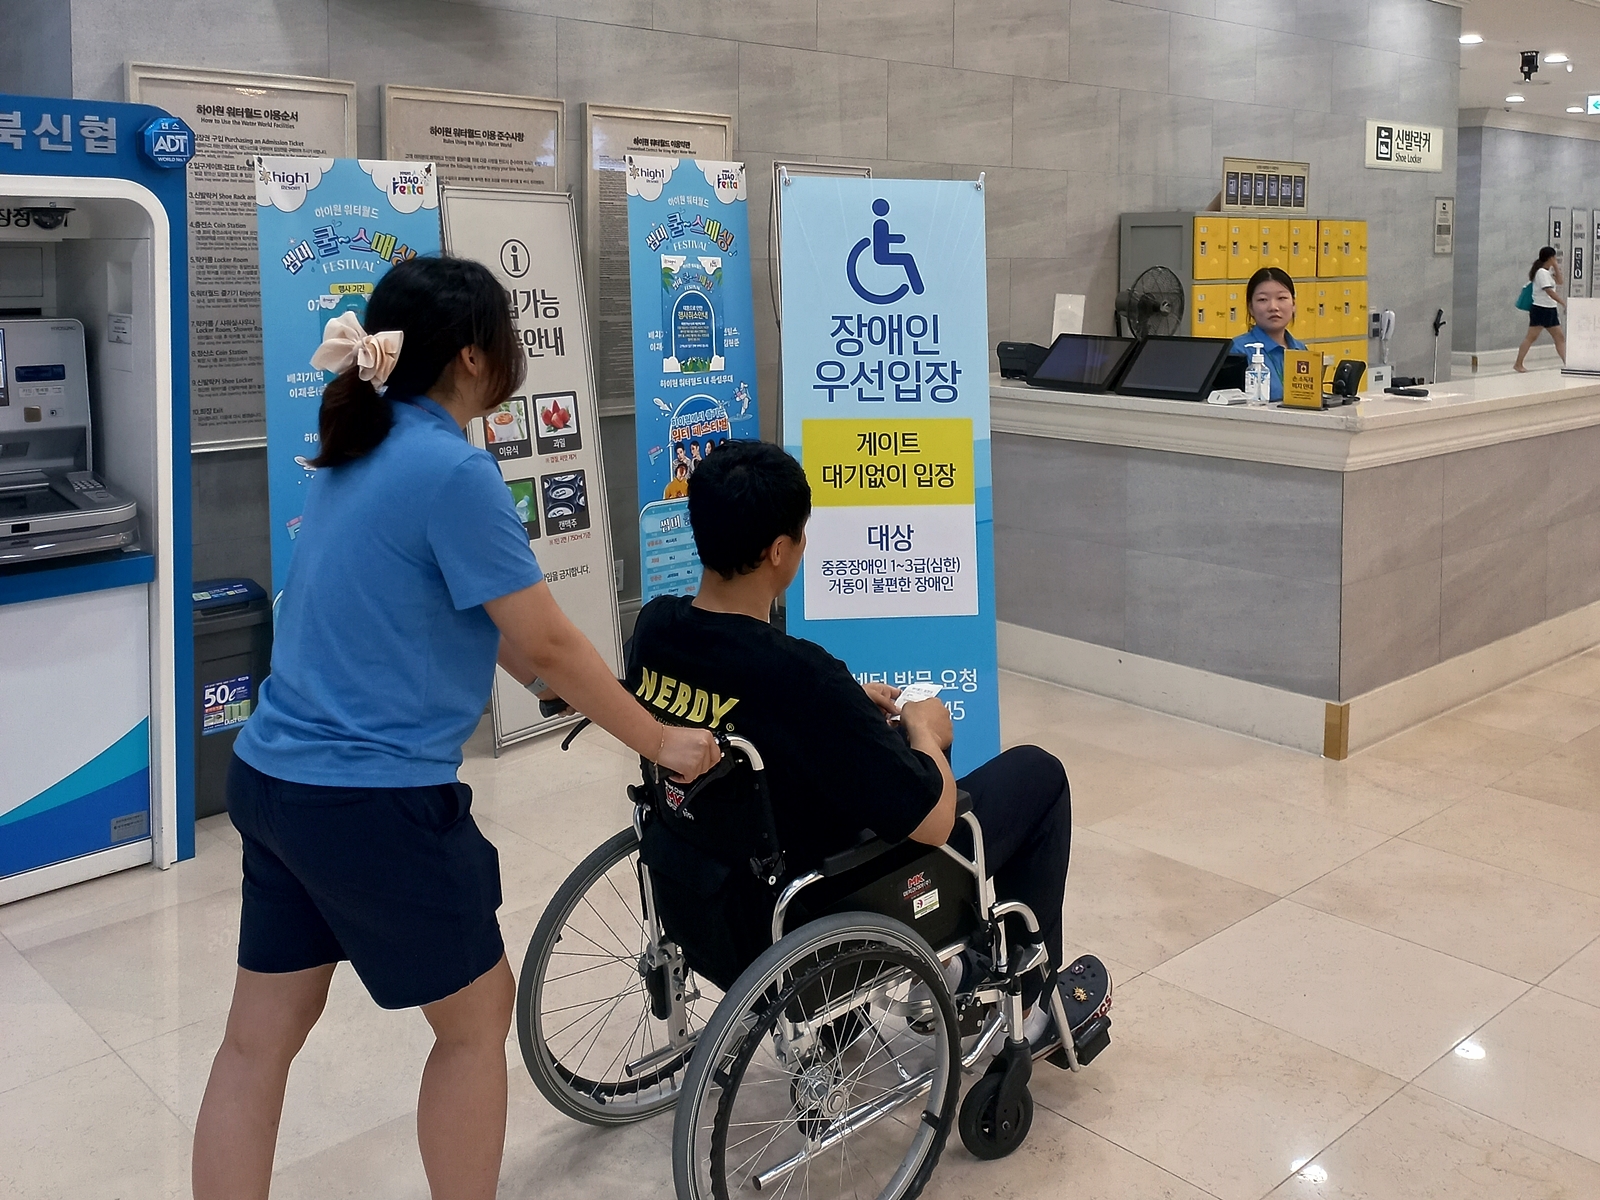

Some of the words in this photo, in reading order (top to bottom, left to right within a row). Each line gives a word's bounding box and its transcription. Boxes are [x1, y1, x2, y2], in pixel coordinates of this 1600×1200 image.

[196, 104, 224, 117] 하이원
[226, 106, 262, 119] 워터월드
[263, 109, 299, 122] 이용순서
[0, 112, 117, 154] 북신협
[224, 136, 254, 145] Purchasing
[429, 126, 452, 138] 하이원
[453, 127, 482, 139] 워터월드
[482, 130, 496, 141] 이용
[1395, 129, 1431, 153] 신발락커
[154, 135, 188, 153] ADT
[1395, 153, 1406, 163] Shoe
[1408, 154, 1422, 164] Locker
[272, 171, 310, 186] high1
[399, 175, 419, 185] 1340
[640, 169, 665, 180] high1
[722, 173, 735, 181] 1340
[392, 178, 424, 195] Festa
[667, 195, 686, 207] 하이원
[314, 204, 342, 218] 하이원
[344, 204, 380, 220] 워터월드
[645, 222, 669, 252] 썸머
[673, 239, 709, 252] FESTIVAL
[281, 240, 316, 276] 썸머
[322, 258, 377, 275] FESTIVAL
[338, 284, 351, 293] 행사
[352, 284, 365, 293] 기간
[519, 327, 566, 358] 안내
[830, 313, 940, 357] 장애인
[812, 360, 962, 403] 우선입장
[499, 444, 520, 457] 이유식
[552, 438, 567, 449] 과일
[856, 431, 921, 457] 게이트
[822, 463, 907, 489] 대기없이
[913, 463, 957, 489] 입장
[660, 514, 681, 533] 썸머
[867, 524, 915, 552] 대상
[821, 558, 887, 576] 중증장애인
[890, 557, 961, 574] 1~3급(심한)
[828, 578, 868, 594] 거동이
[872, 576, 912, 593] 불편한
[914, 575, 955, 592] 장애인
[941, 668, 978, 692] 요청
[635, 666, 740, 729] NERDY
